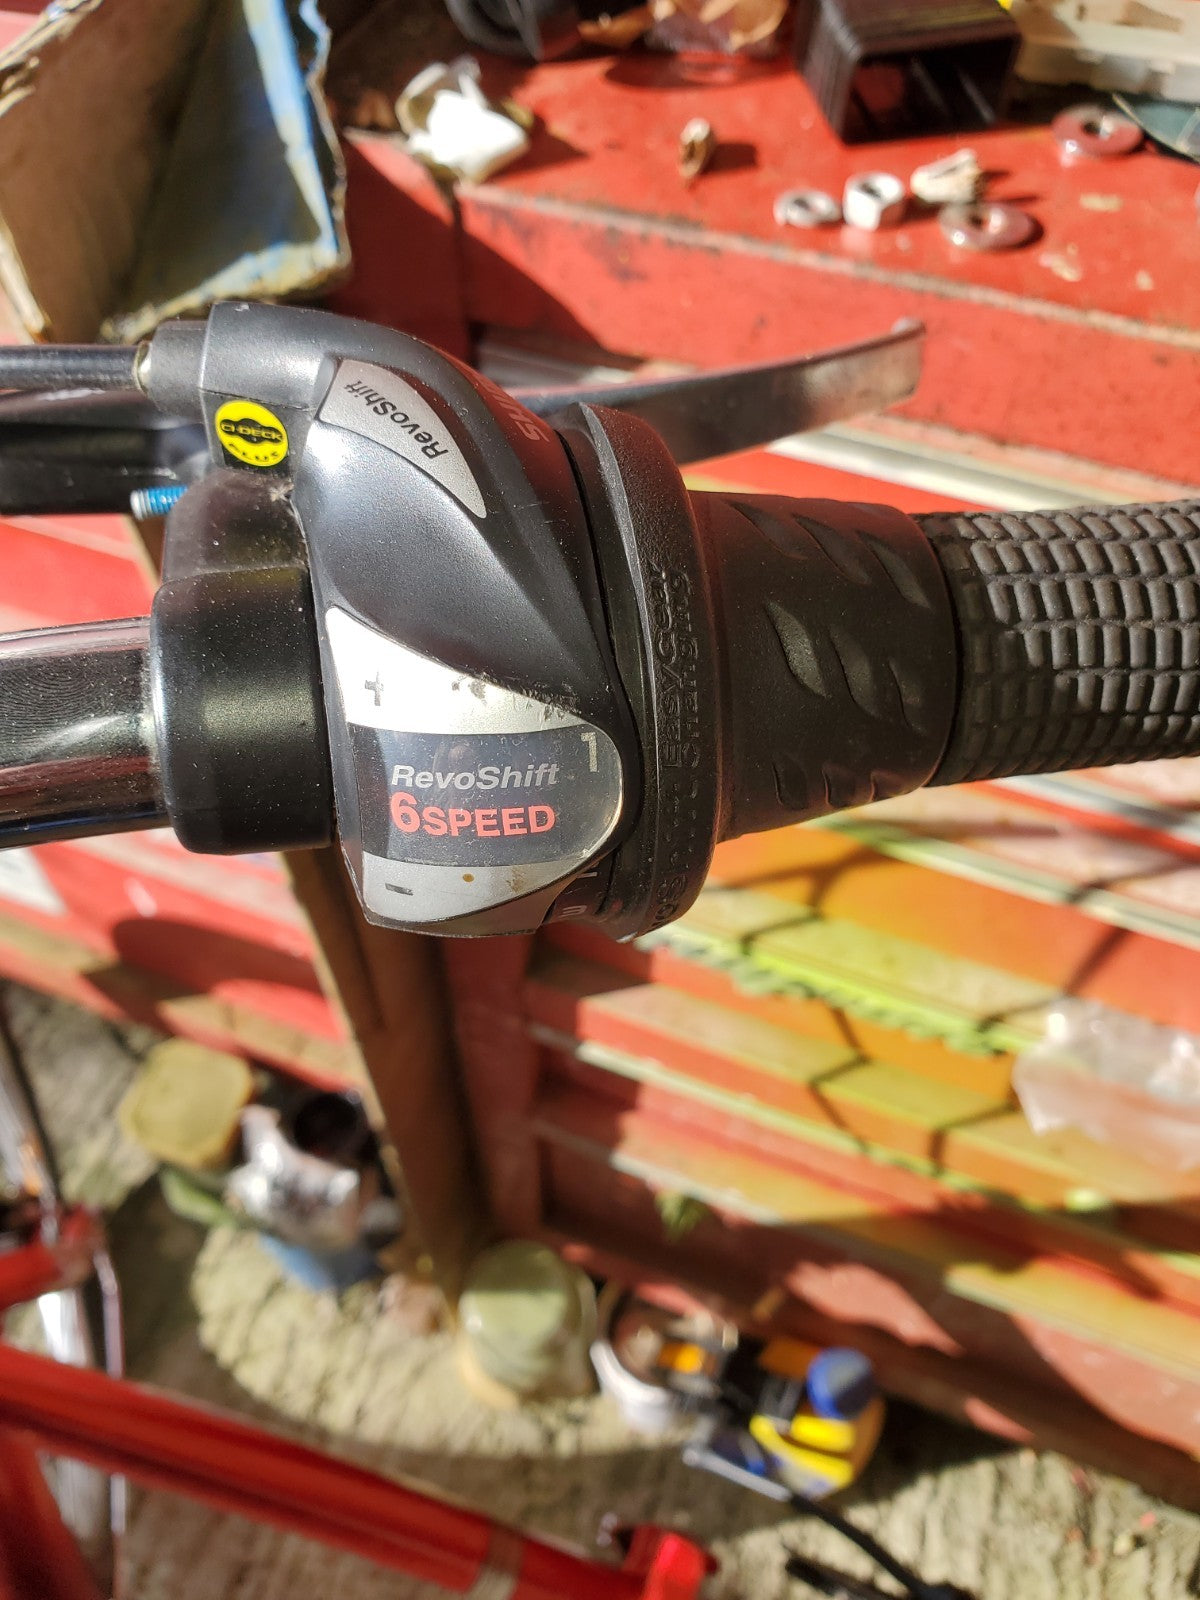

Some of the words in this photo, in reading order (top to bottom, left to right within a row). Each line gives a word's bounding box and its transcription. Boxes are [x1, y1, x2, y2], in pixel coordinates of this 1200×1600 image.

[344, 380, 449, 459] RevoShift
[580, 731, 600, 774] 1
[391, 763, 560, 790] RevoShift
[390, 791, 557, 837] 6SPEED
